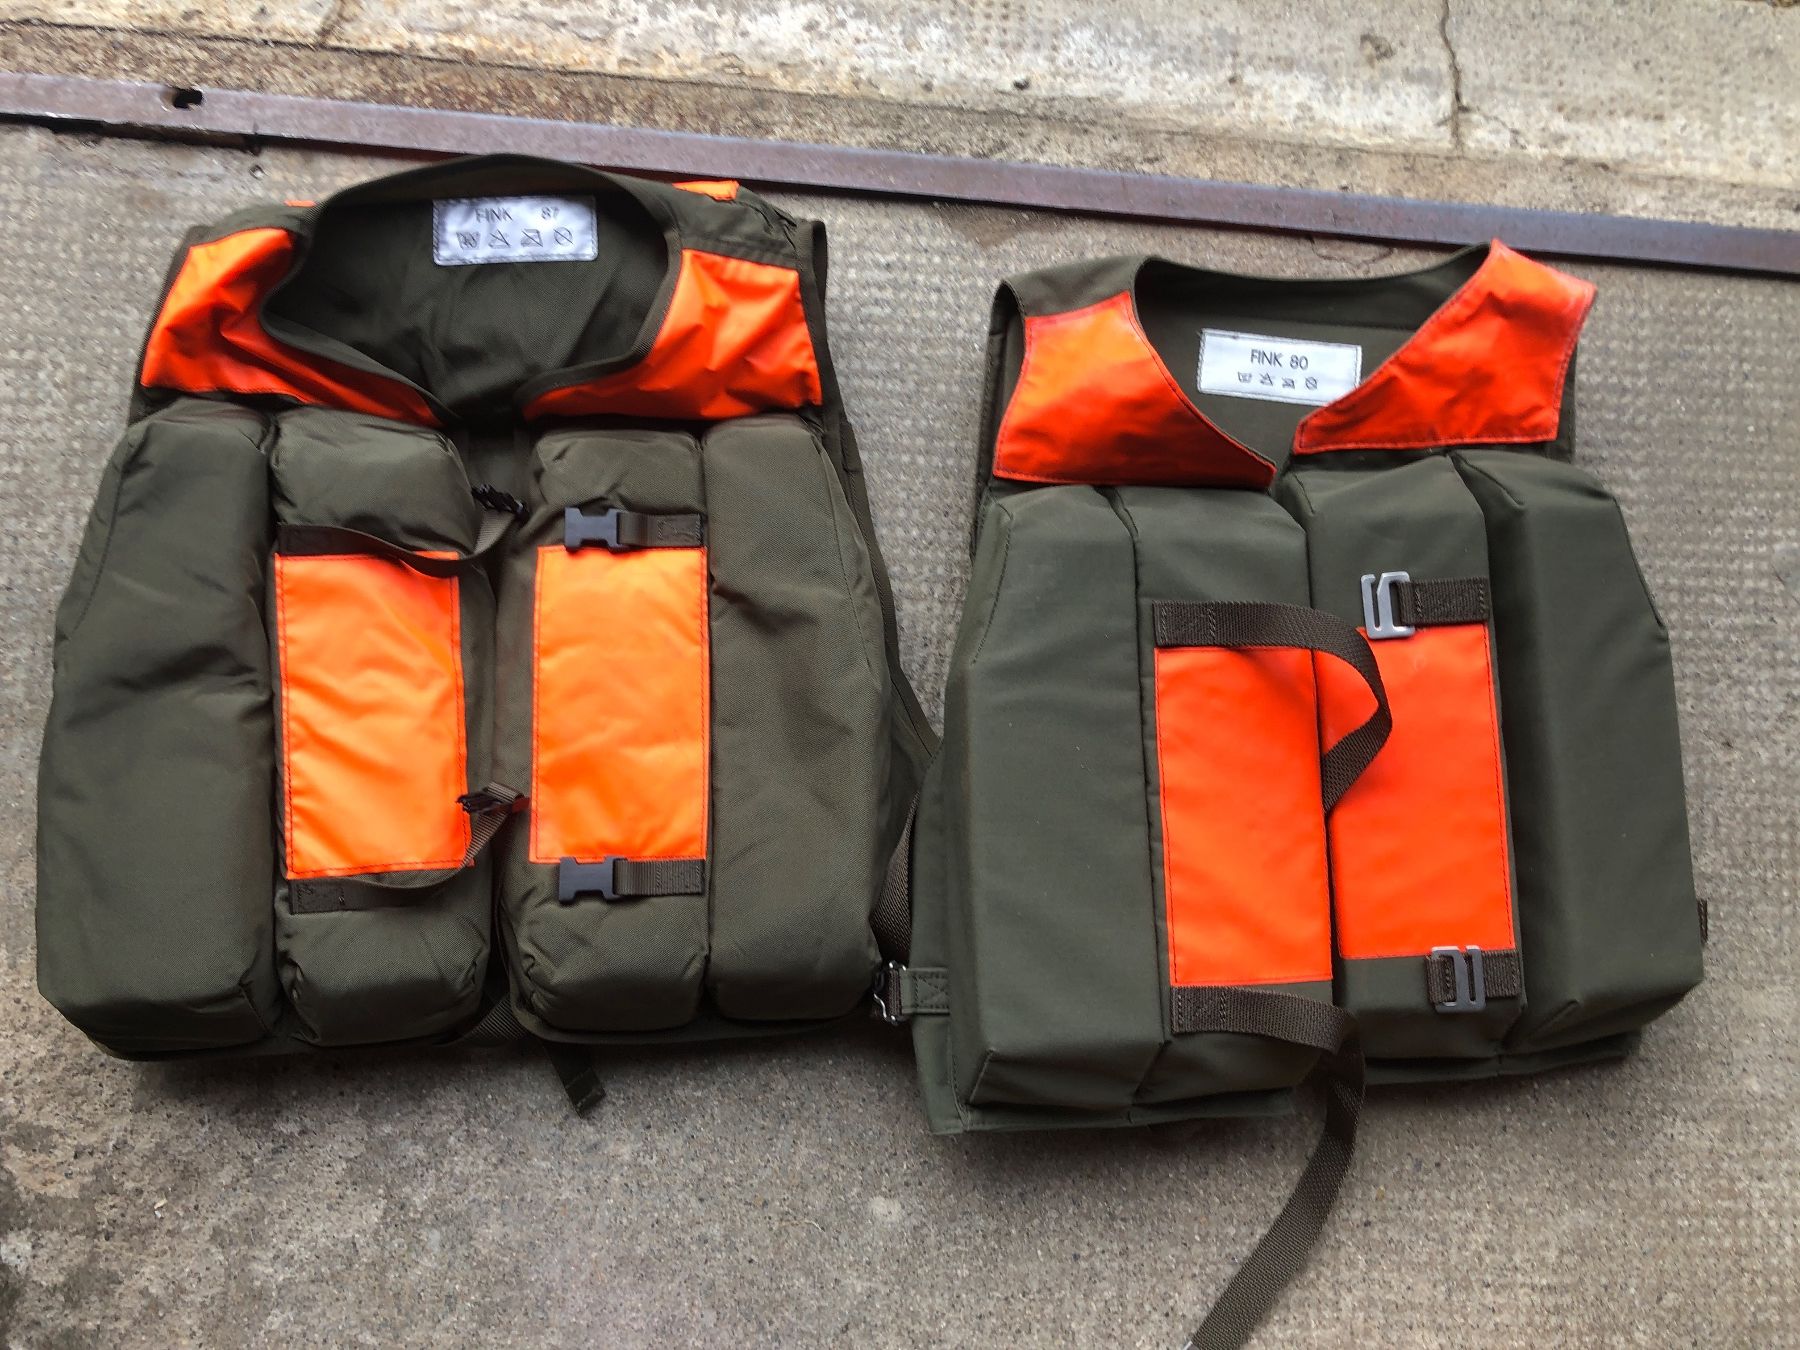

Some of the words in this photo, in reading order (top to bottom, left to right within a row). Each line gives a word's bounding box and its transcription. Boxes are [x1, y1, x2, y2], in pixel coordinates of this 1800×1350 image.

[475, 207, 513, 223] FINK
[541, 206, 560, 220] 87
[1250, 348, 1283, 368] FINK
[1289, 354, 1309, 370] 80
